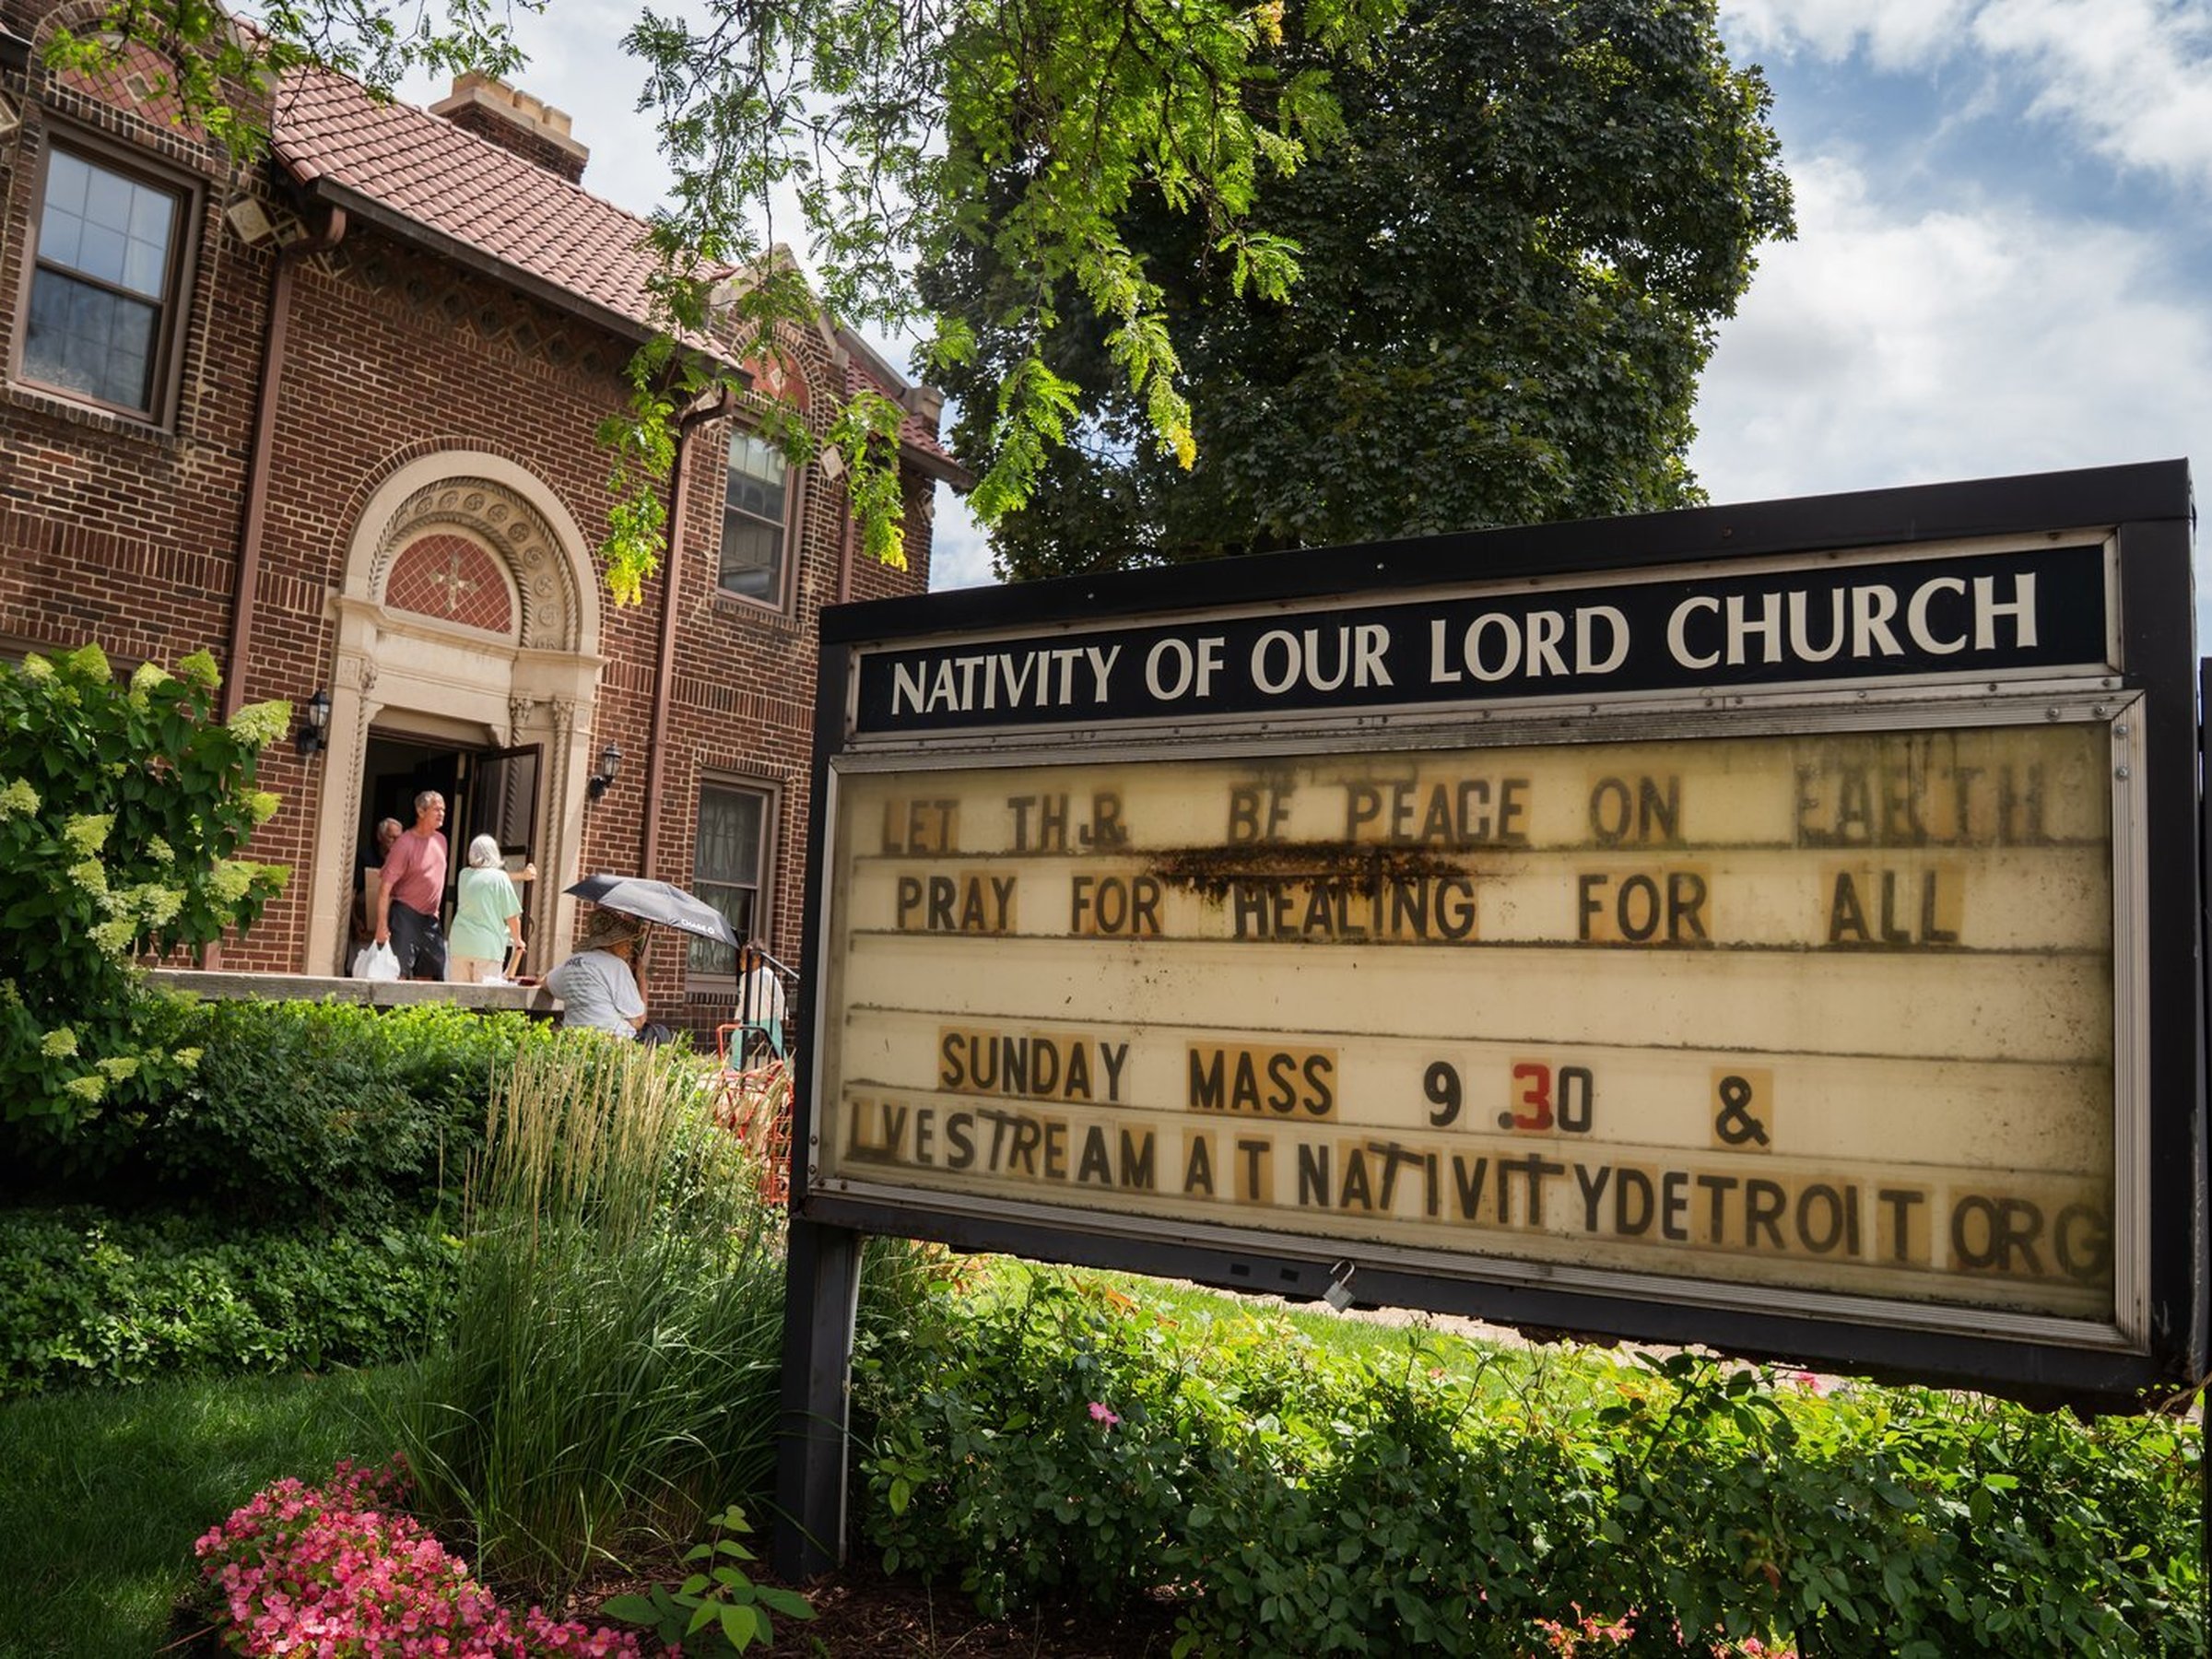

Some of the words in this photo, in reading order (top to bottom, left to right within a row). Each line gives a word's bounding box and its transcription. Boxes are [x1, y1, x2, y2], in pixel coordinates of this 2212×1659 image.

[891, 645, 1121, 715] NATIVITY
[1145, 637, 1224, 700] OF
[1251, 624, 1394, 694] OUR
[1430, 606, 1630, 684] LORD
[1666, 572, 2037, 669] CHURCH
[880, 798, 960, 854] LET
[1229, 782, 1291, 845] BE
[1347, 778, 1530, 844] PEACE
[1589, 775, 1680, 842] ON
[897, 876, 1017, 931] PRAY
[1072, 875, 1161, 934] FOR
[1233, 876, 1475, 940] HEALING
[1578, 873, 1708, 941] FOR
[1829, 869, 1958, 943] ALL
[942, 1033, 1129, 1101] SUNDAY
[1189, 1049, 1334, 1115] MASS
[1715, 1075, 1771, 1147] &
